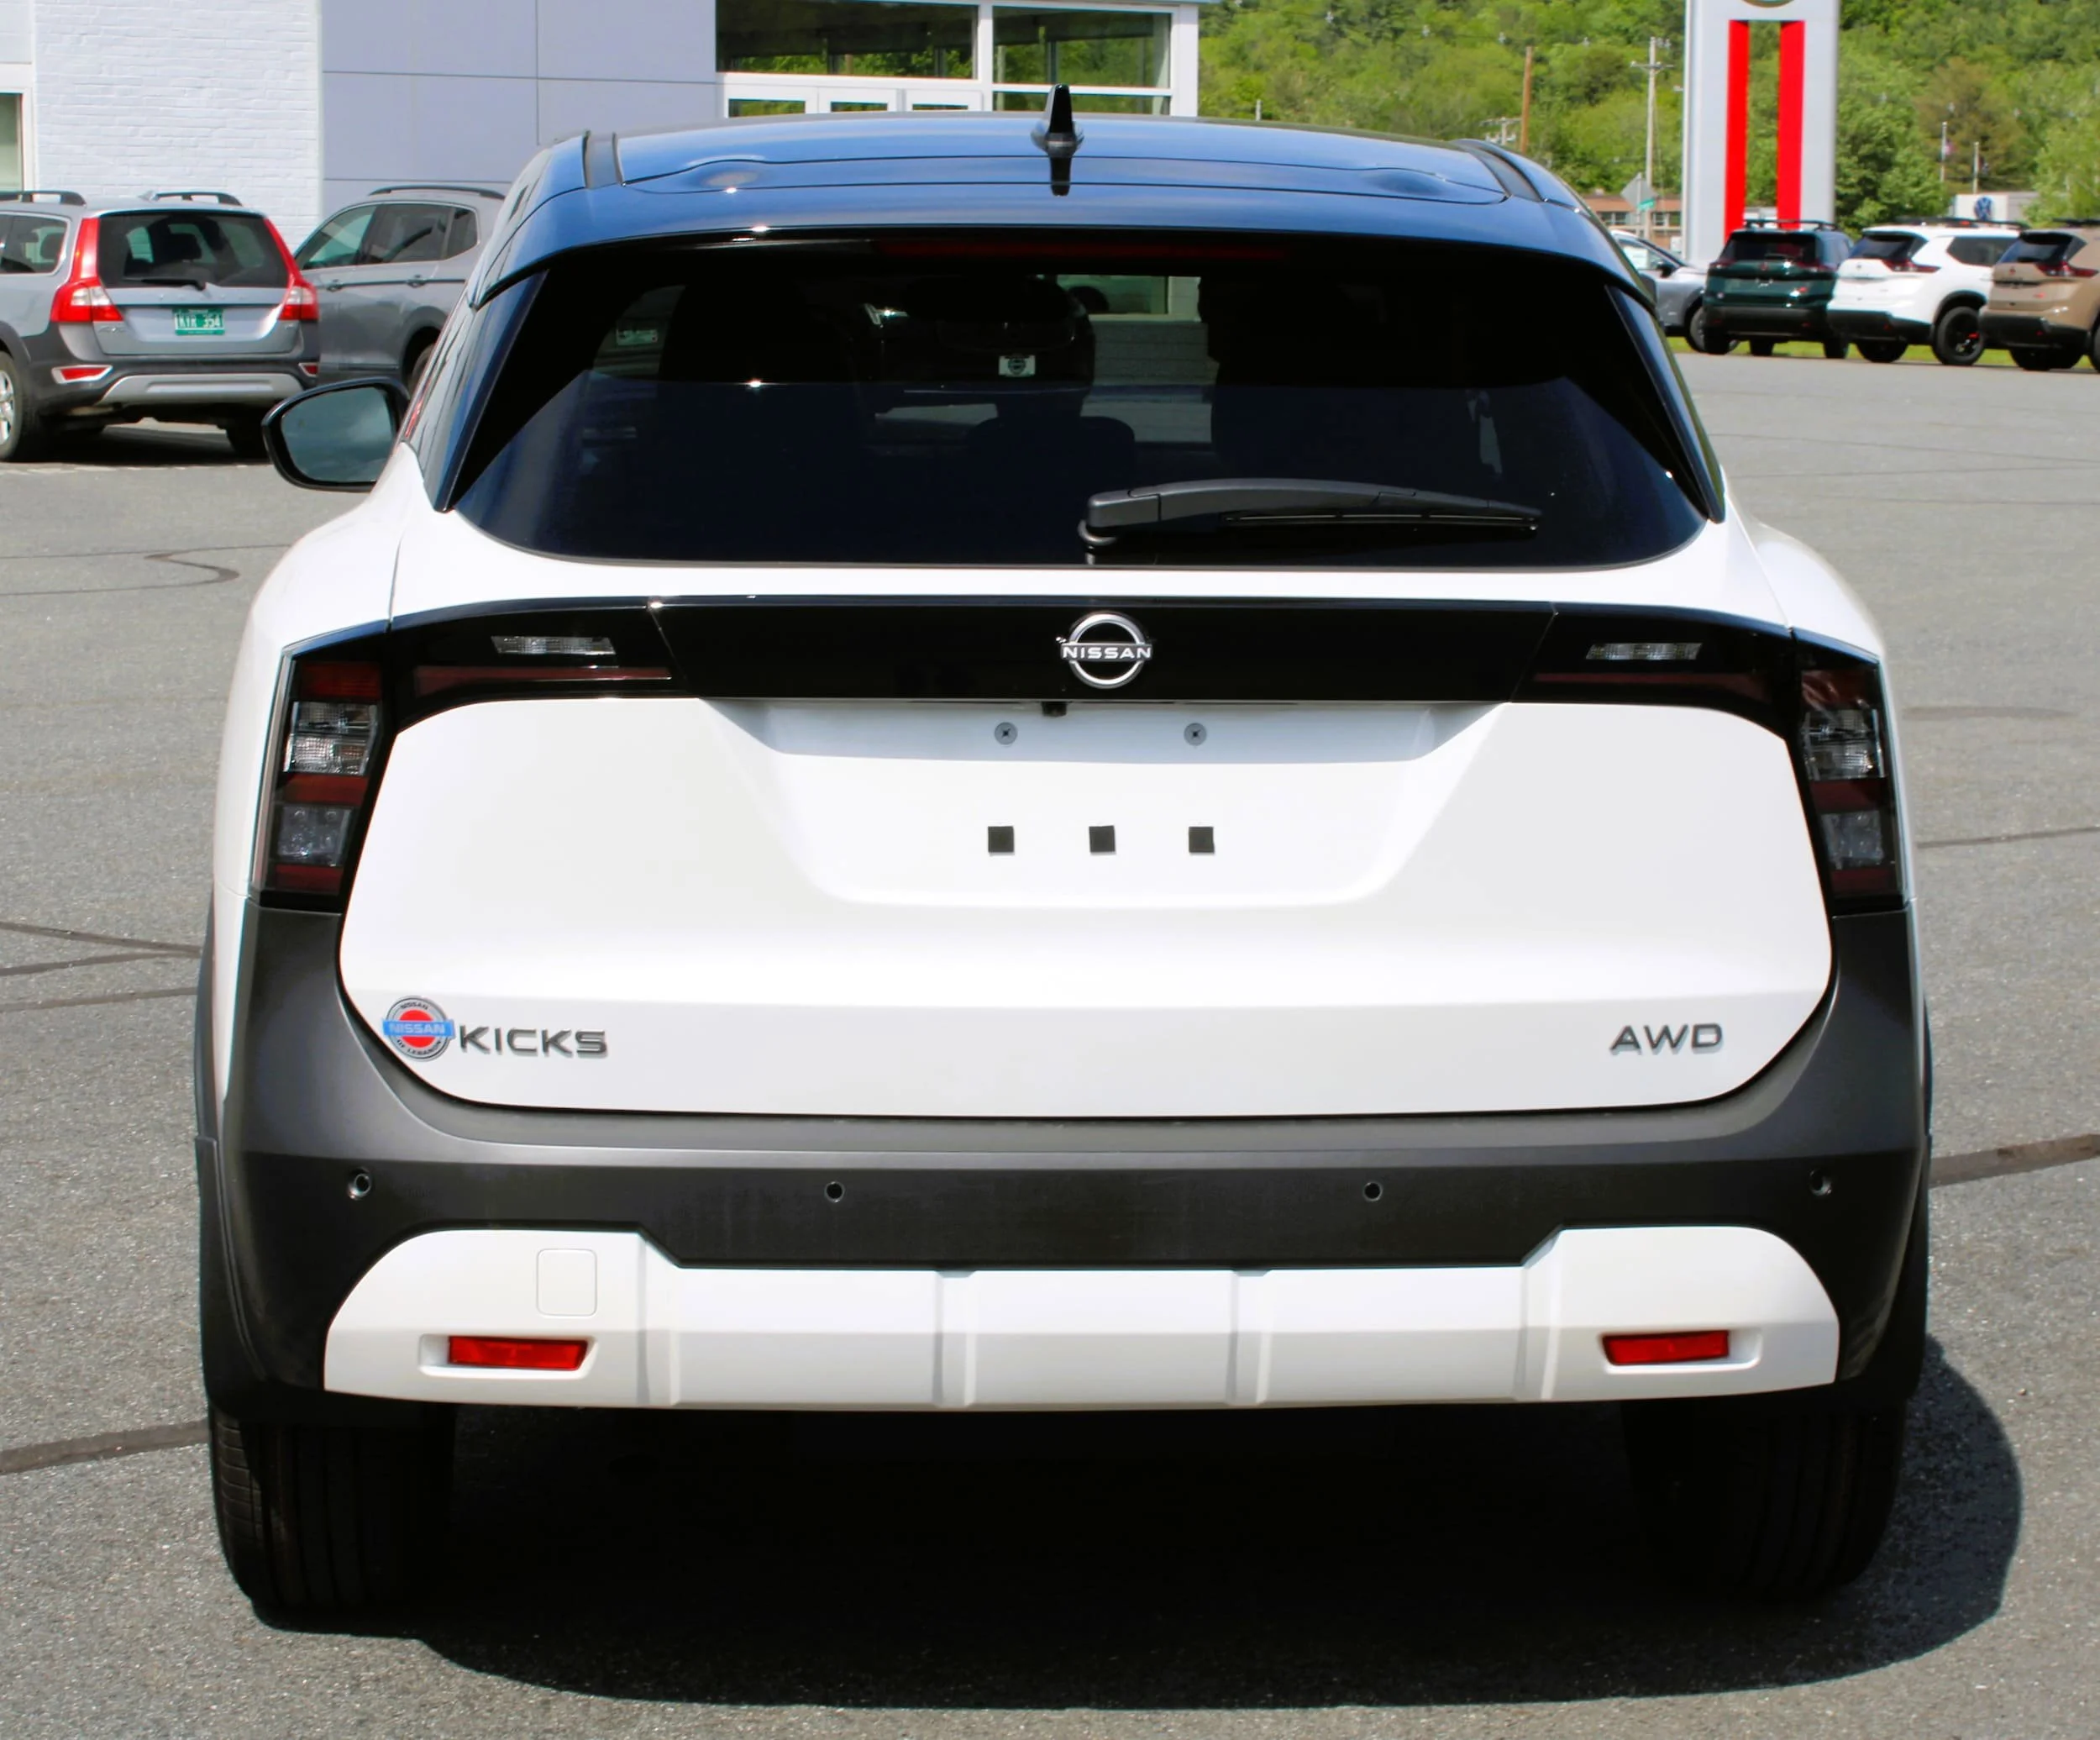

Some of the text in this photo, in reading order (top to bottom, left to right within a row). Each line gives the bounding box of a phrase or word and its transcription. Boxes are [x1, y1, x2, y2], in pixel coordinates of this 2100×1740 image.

[1063, 647, 1151, 659] NISSAN
[389, 1022, 445, 1034] NISSAN
[1609, 1023, 1722, 1052] AWD
[459, 1025, 607, 1057] KICKS
